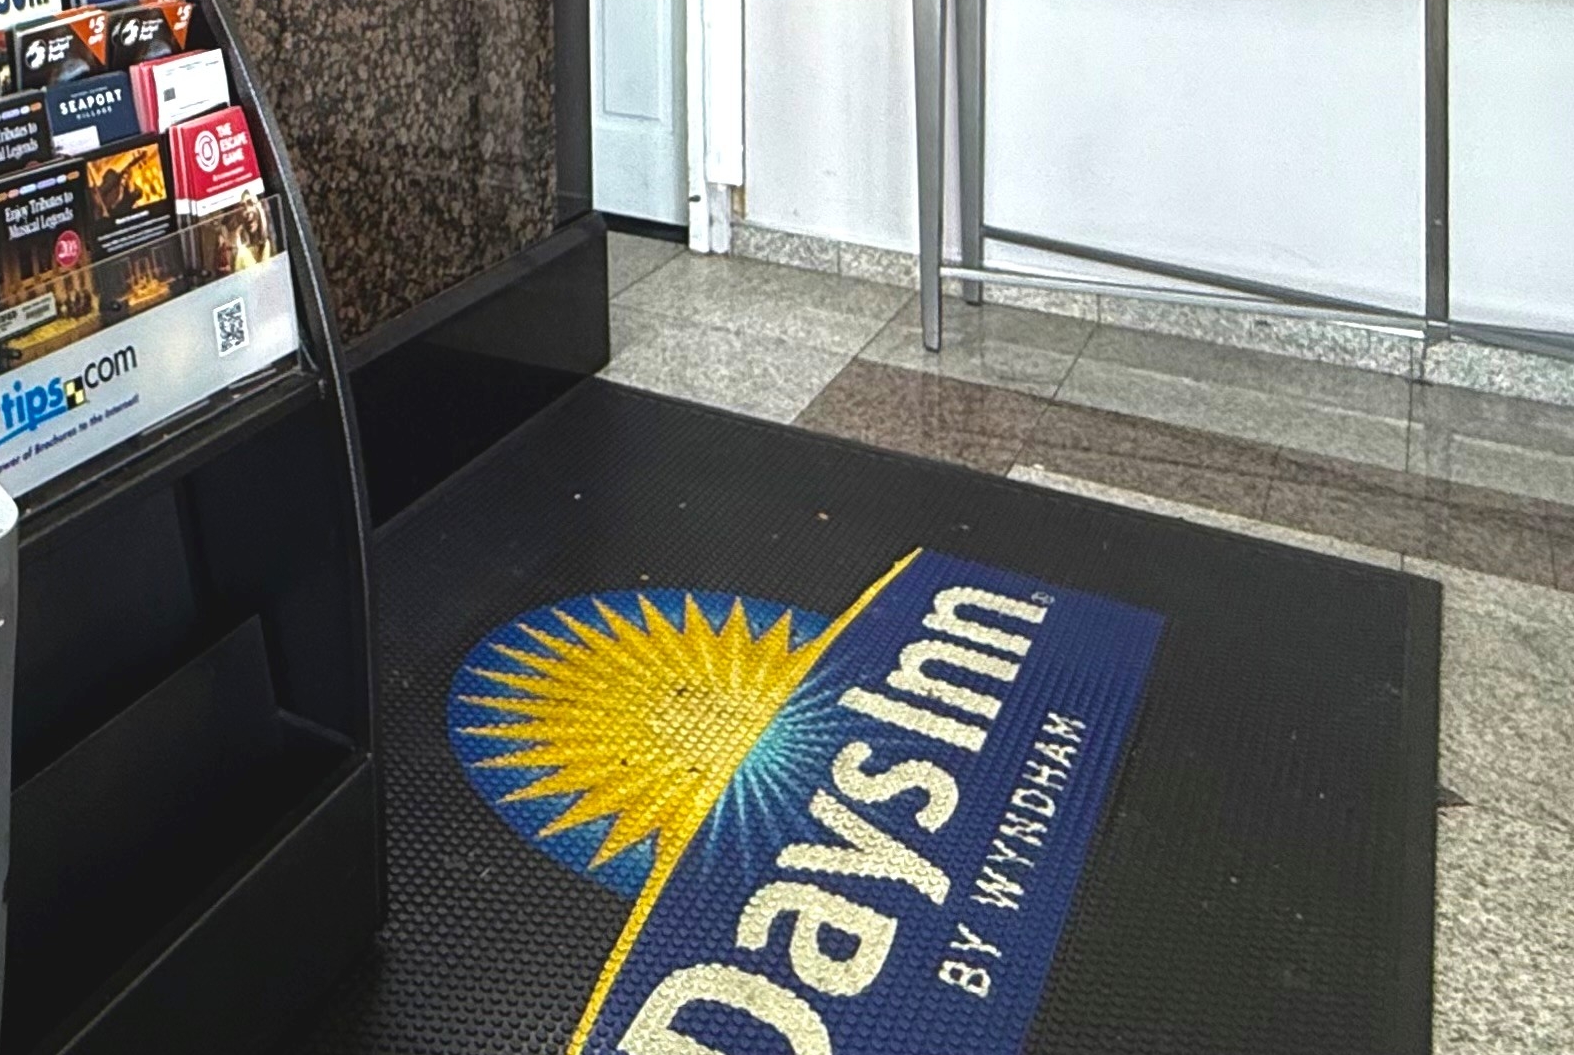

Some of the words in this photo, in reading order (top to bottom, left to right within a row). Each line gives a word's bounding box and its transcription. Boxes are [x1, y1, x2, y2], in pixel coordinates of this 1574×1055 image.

[59, 88, 122, 116] SEAPORT
[6, 137, 39, 160] Legends
[4, 205, 29, 224] Enjoy
[28, 194, 64, 215] Tributes
[8, 216, 41, 241] Musical
[40, 206, 74, 230] Legends
[23, 447, 33, 461] of
[34, 428, 78, 454] Brochures
[78, 421, 88, 432] to
[90, 414, 104, 427] the
[615, 741, 960, 1055] Days
[838, 585, 1050, 753] Inn
[936, 923, 1002, 999] BY
[971, 712, 1087, 911] WYNDHAM
